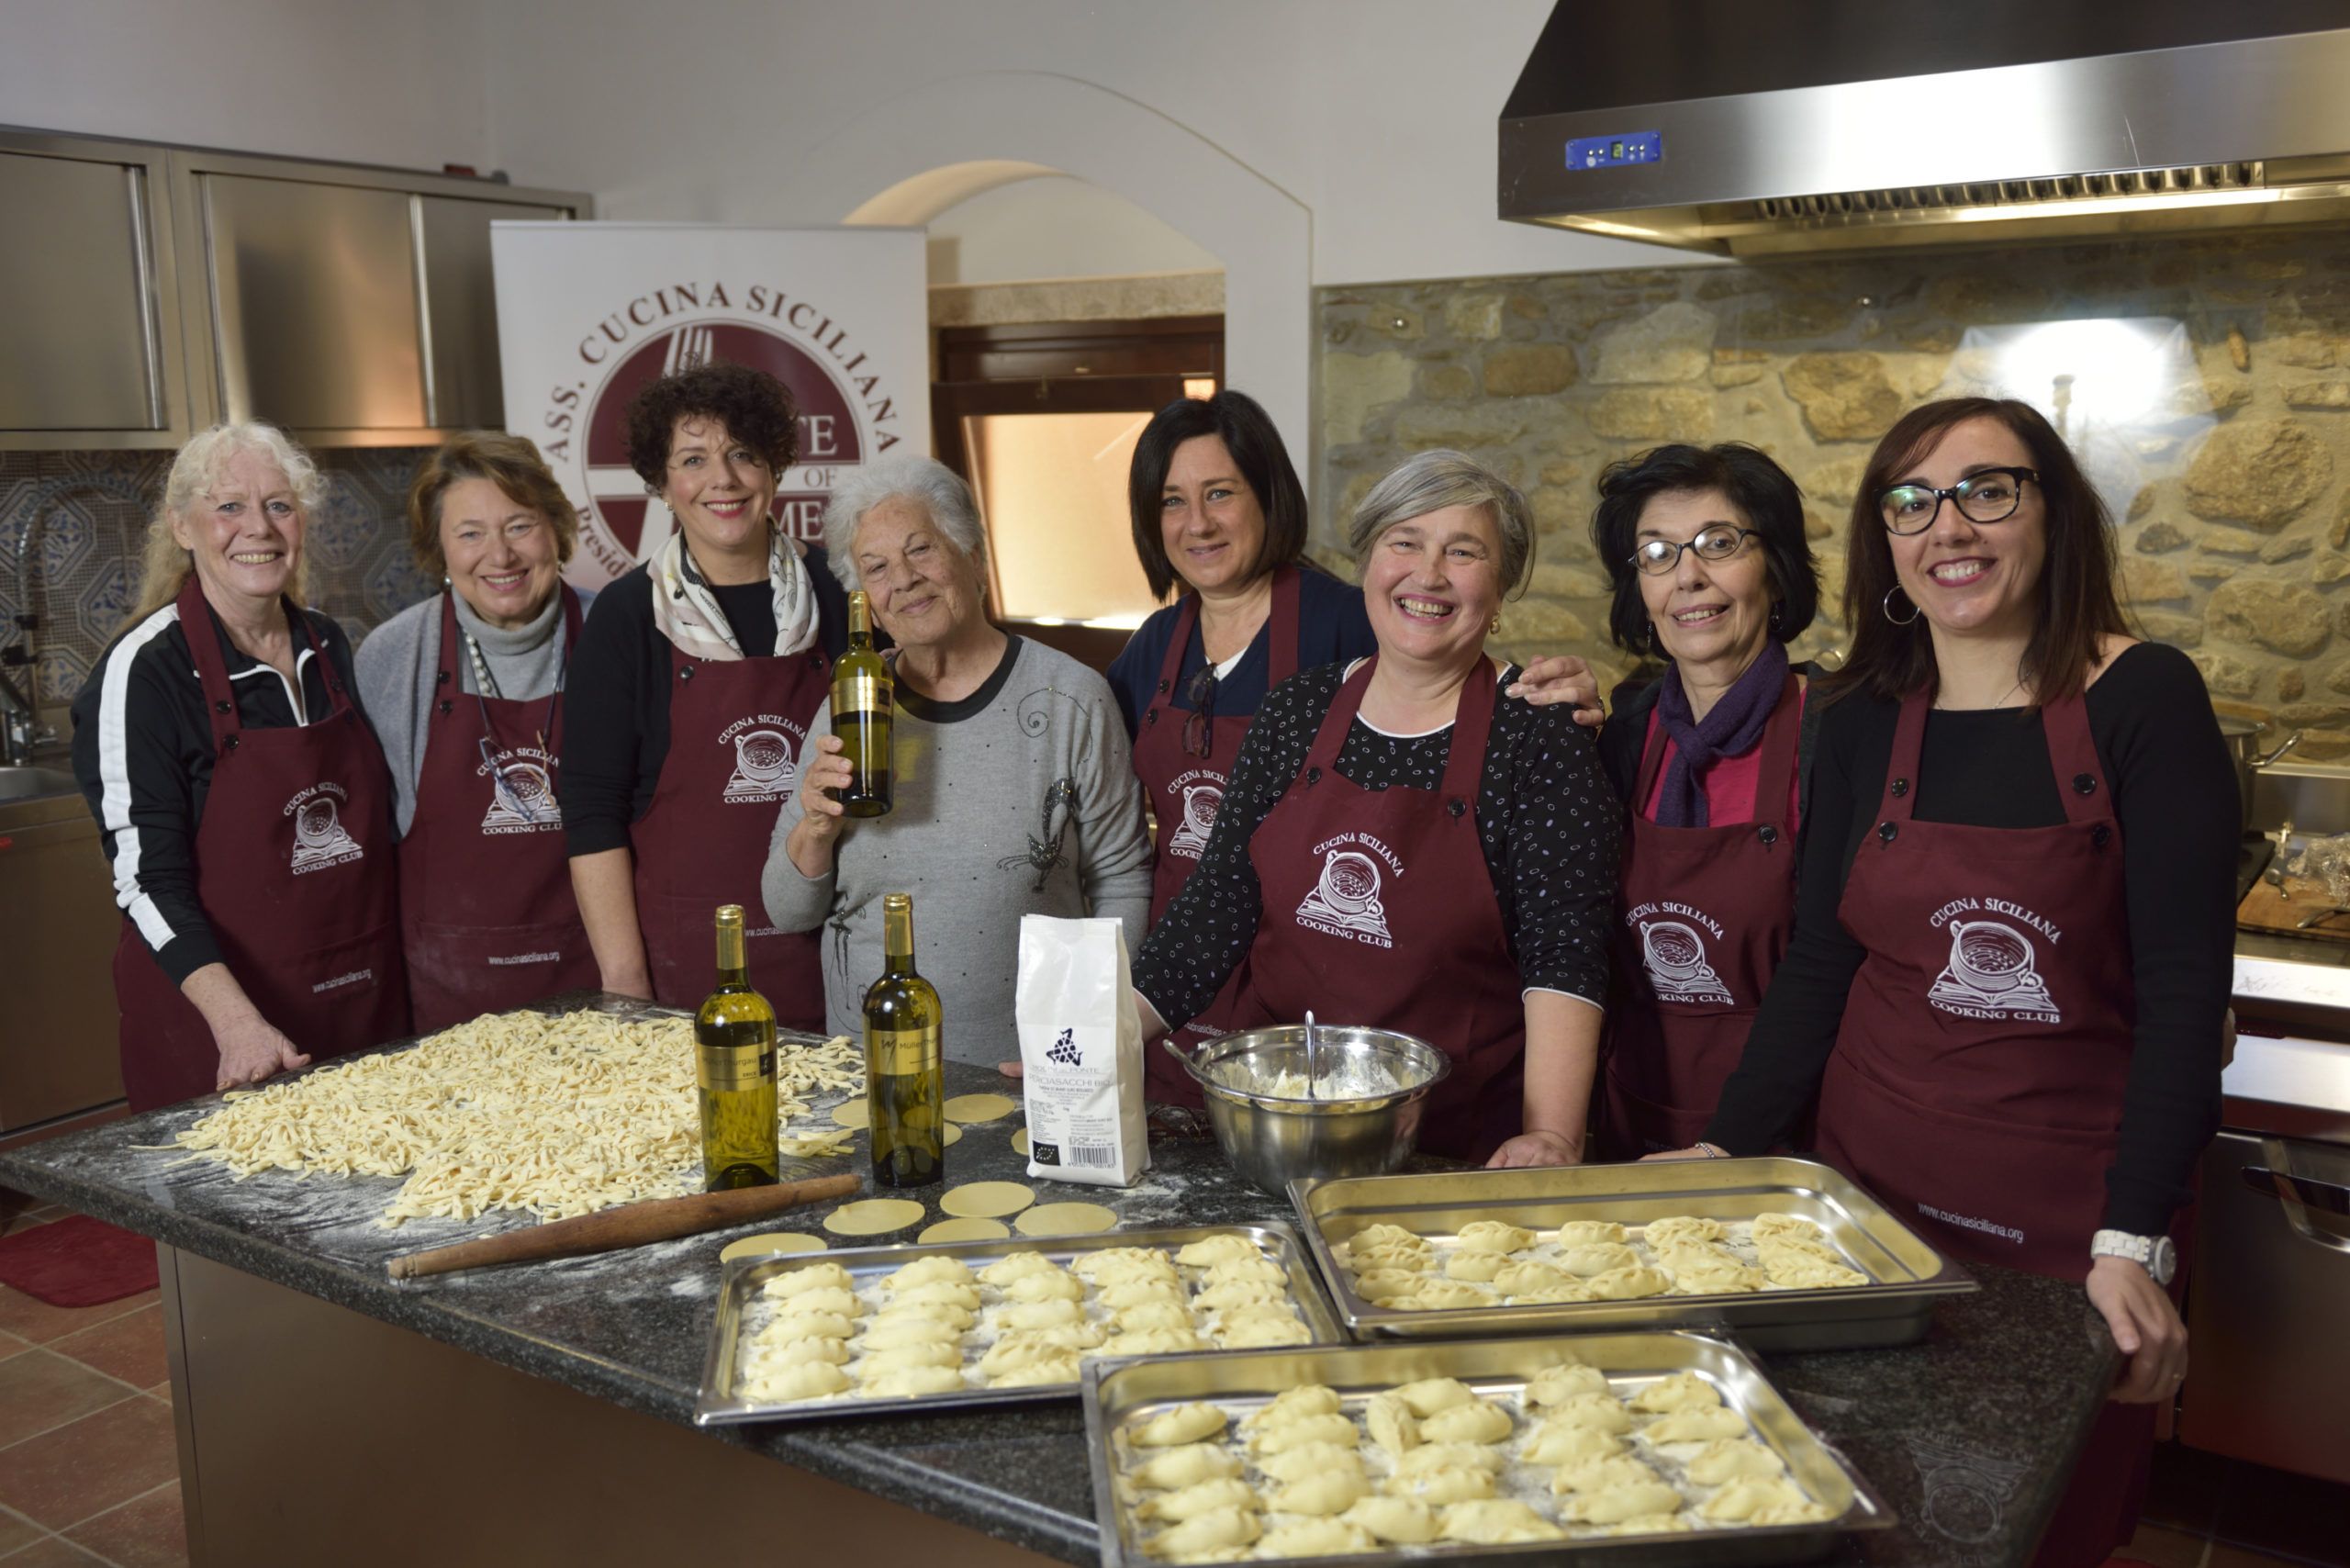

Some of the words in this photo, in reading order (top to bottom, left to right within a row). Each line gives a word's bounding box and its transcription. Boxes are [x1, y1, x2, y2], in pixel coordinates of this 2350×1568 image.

[543, 381, 586, 463] ASS.
[579, 281, 733, 365] CUCINA
[745, 285, 901, 454] SICILIANA
[718, 716, 755, 745] CUCINA
[757, 714, 807, 740] SICILIANA
[1168, 769, 1201, 794] CUCINA
[283, 787, 318, 816] CUCINA
[724, 793, 777, 804] COOKING
[482, 824, 536, 835] COOKING
[292, 857, 337, 875] COOKING
[338, 850, 364, 863] CLUB
[1313, 832, 1356, 855] CUCINA
[1359, 832, 1404, 878] SICILIANA
[1296, 916, 1354, 939] COOKING
[1358, 934, 1393, 948] CLUB
[1626, 902, 1659, 926] CUCINA
[1662, 902, 1724, 941] SICILIANA
[1930, 897, 1980, 927] CUCINA
[1985, 897, 2062, 945] SICILIANA
[1698, 994, 1734, 1005] CLUB
[1930, 1000, 2007, 1019] COOKING
[2013, 1012, 2060, 1024] CLUB
[1917, 1202, 2024, 1244] www.cucinasiciliana.org
